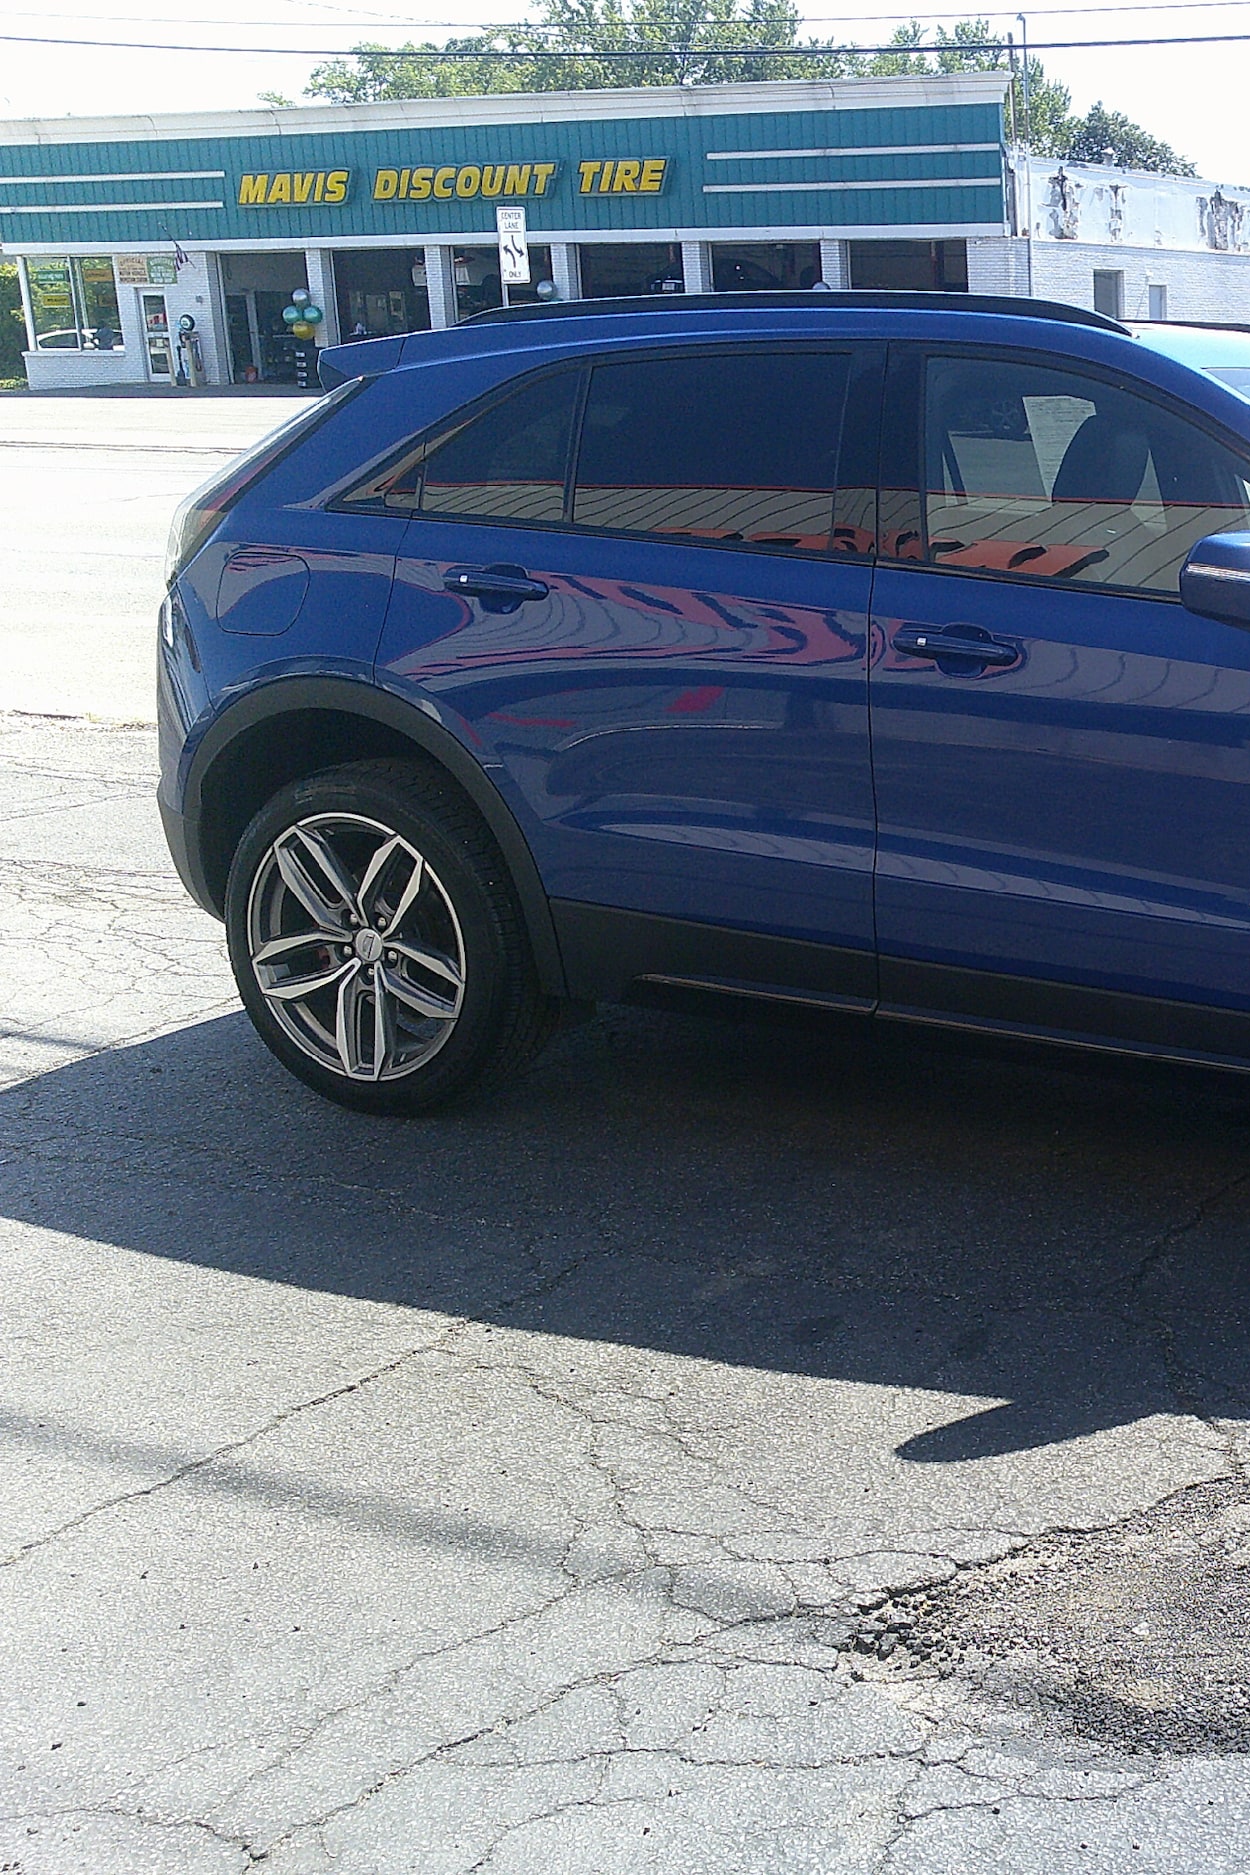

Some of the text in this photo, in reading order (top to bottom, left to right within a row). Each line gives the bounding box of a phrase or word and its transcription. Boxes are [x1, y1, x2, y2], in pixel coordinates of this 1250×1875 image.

[238, 159, 667, 205] MAVIS DISCOUNT TIRE
[501, 212, 521, 220] CENTER
